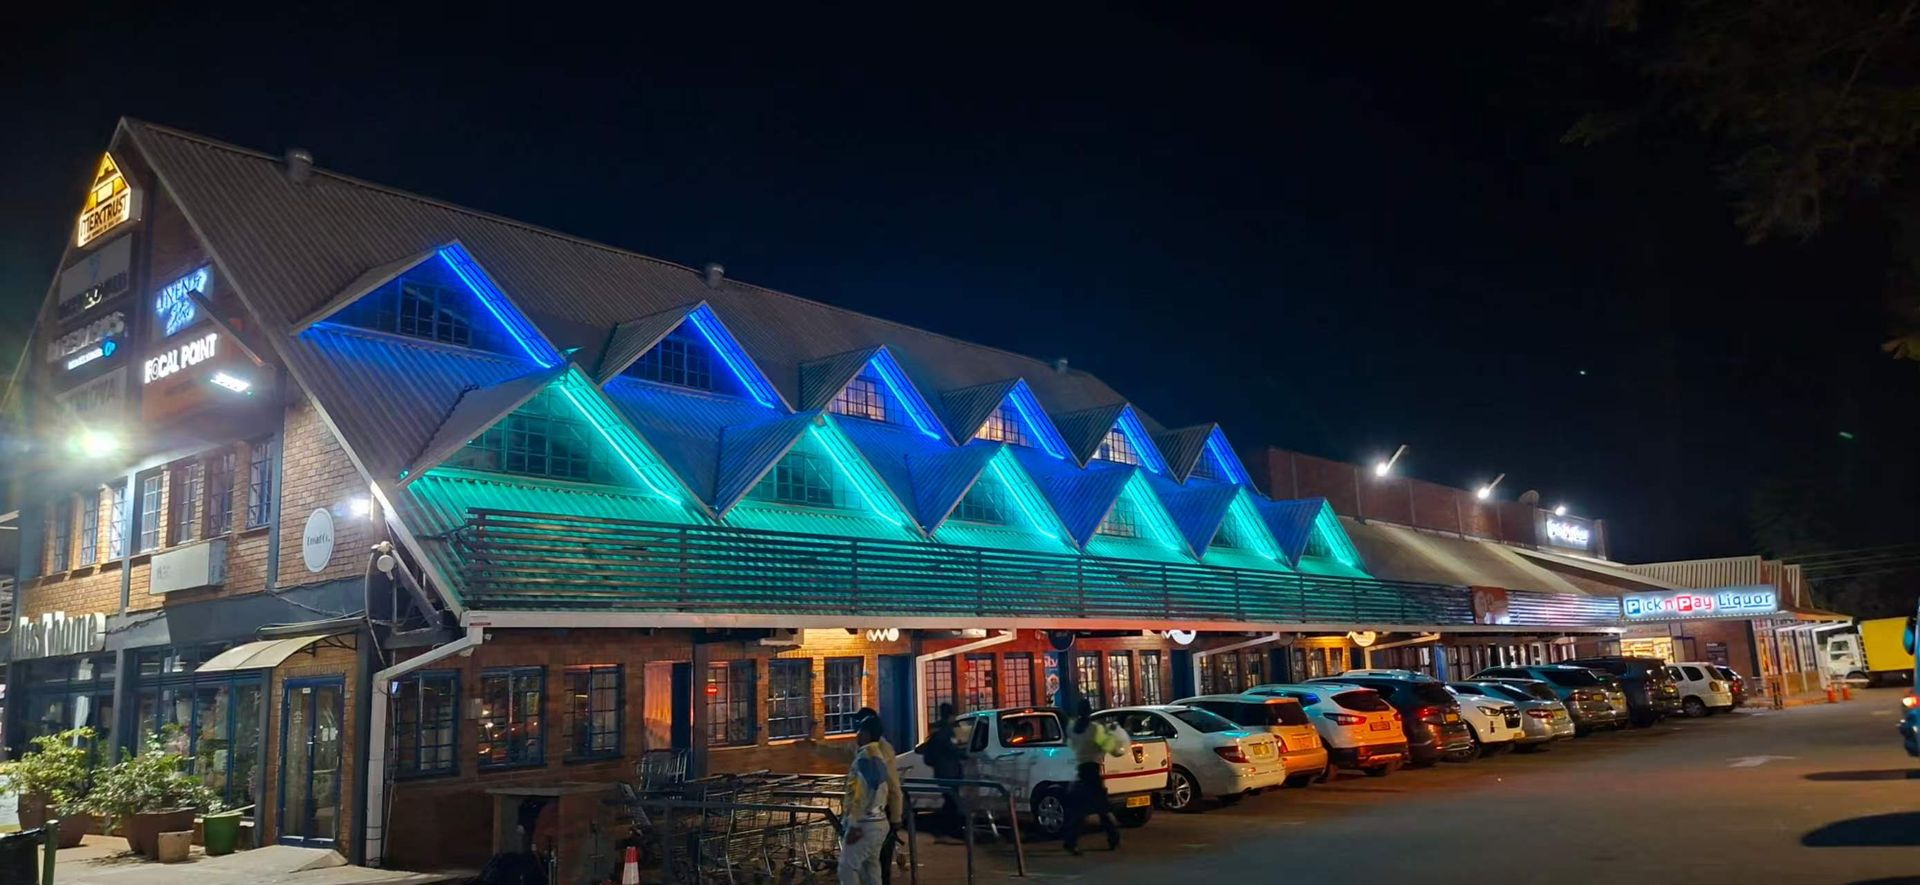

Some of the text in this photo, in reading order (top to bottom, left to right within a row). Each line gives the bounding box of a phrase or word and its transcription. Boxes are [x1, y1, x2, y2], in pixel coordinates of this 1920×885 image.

[144, 350, 180, 384] FOCAL
[181, 333, 218, 369] POINT
[1626, 592, 1772, 615] Pick n Pay Liquor
